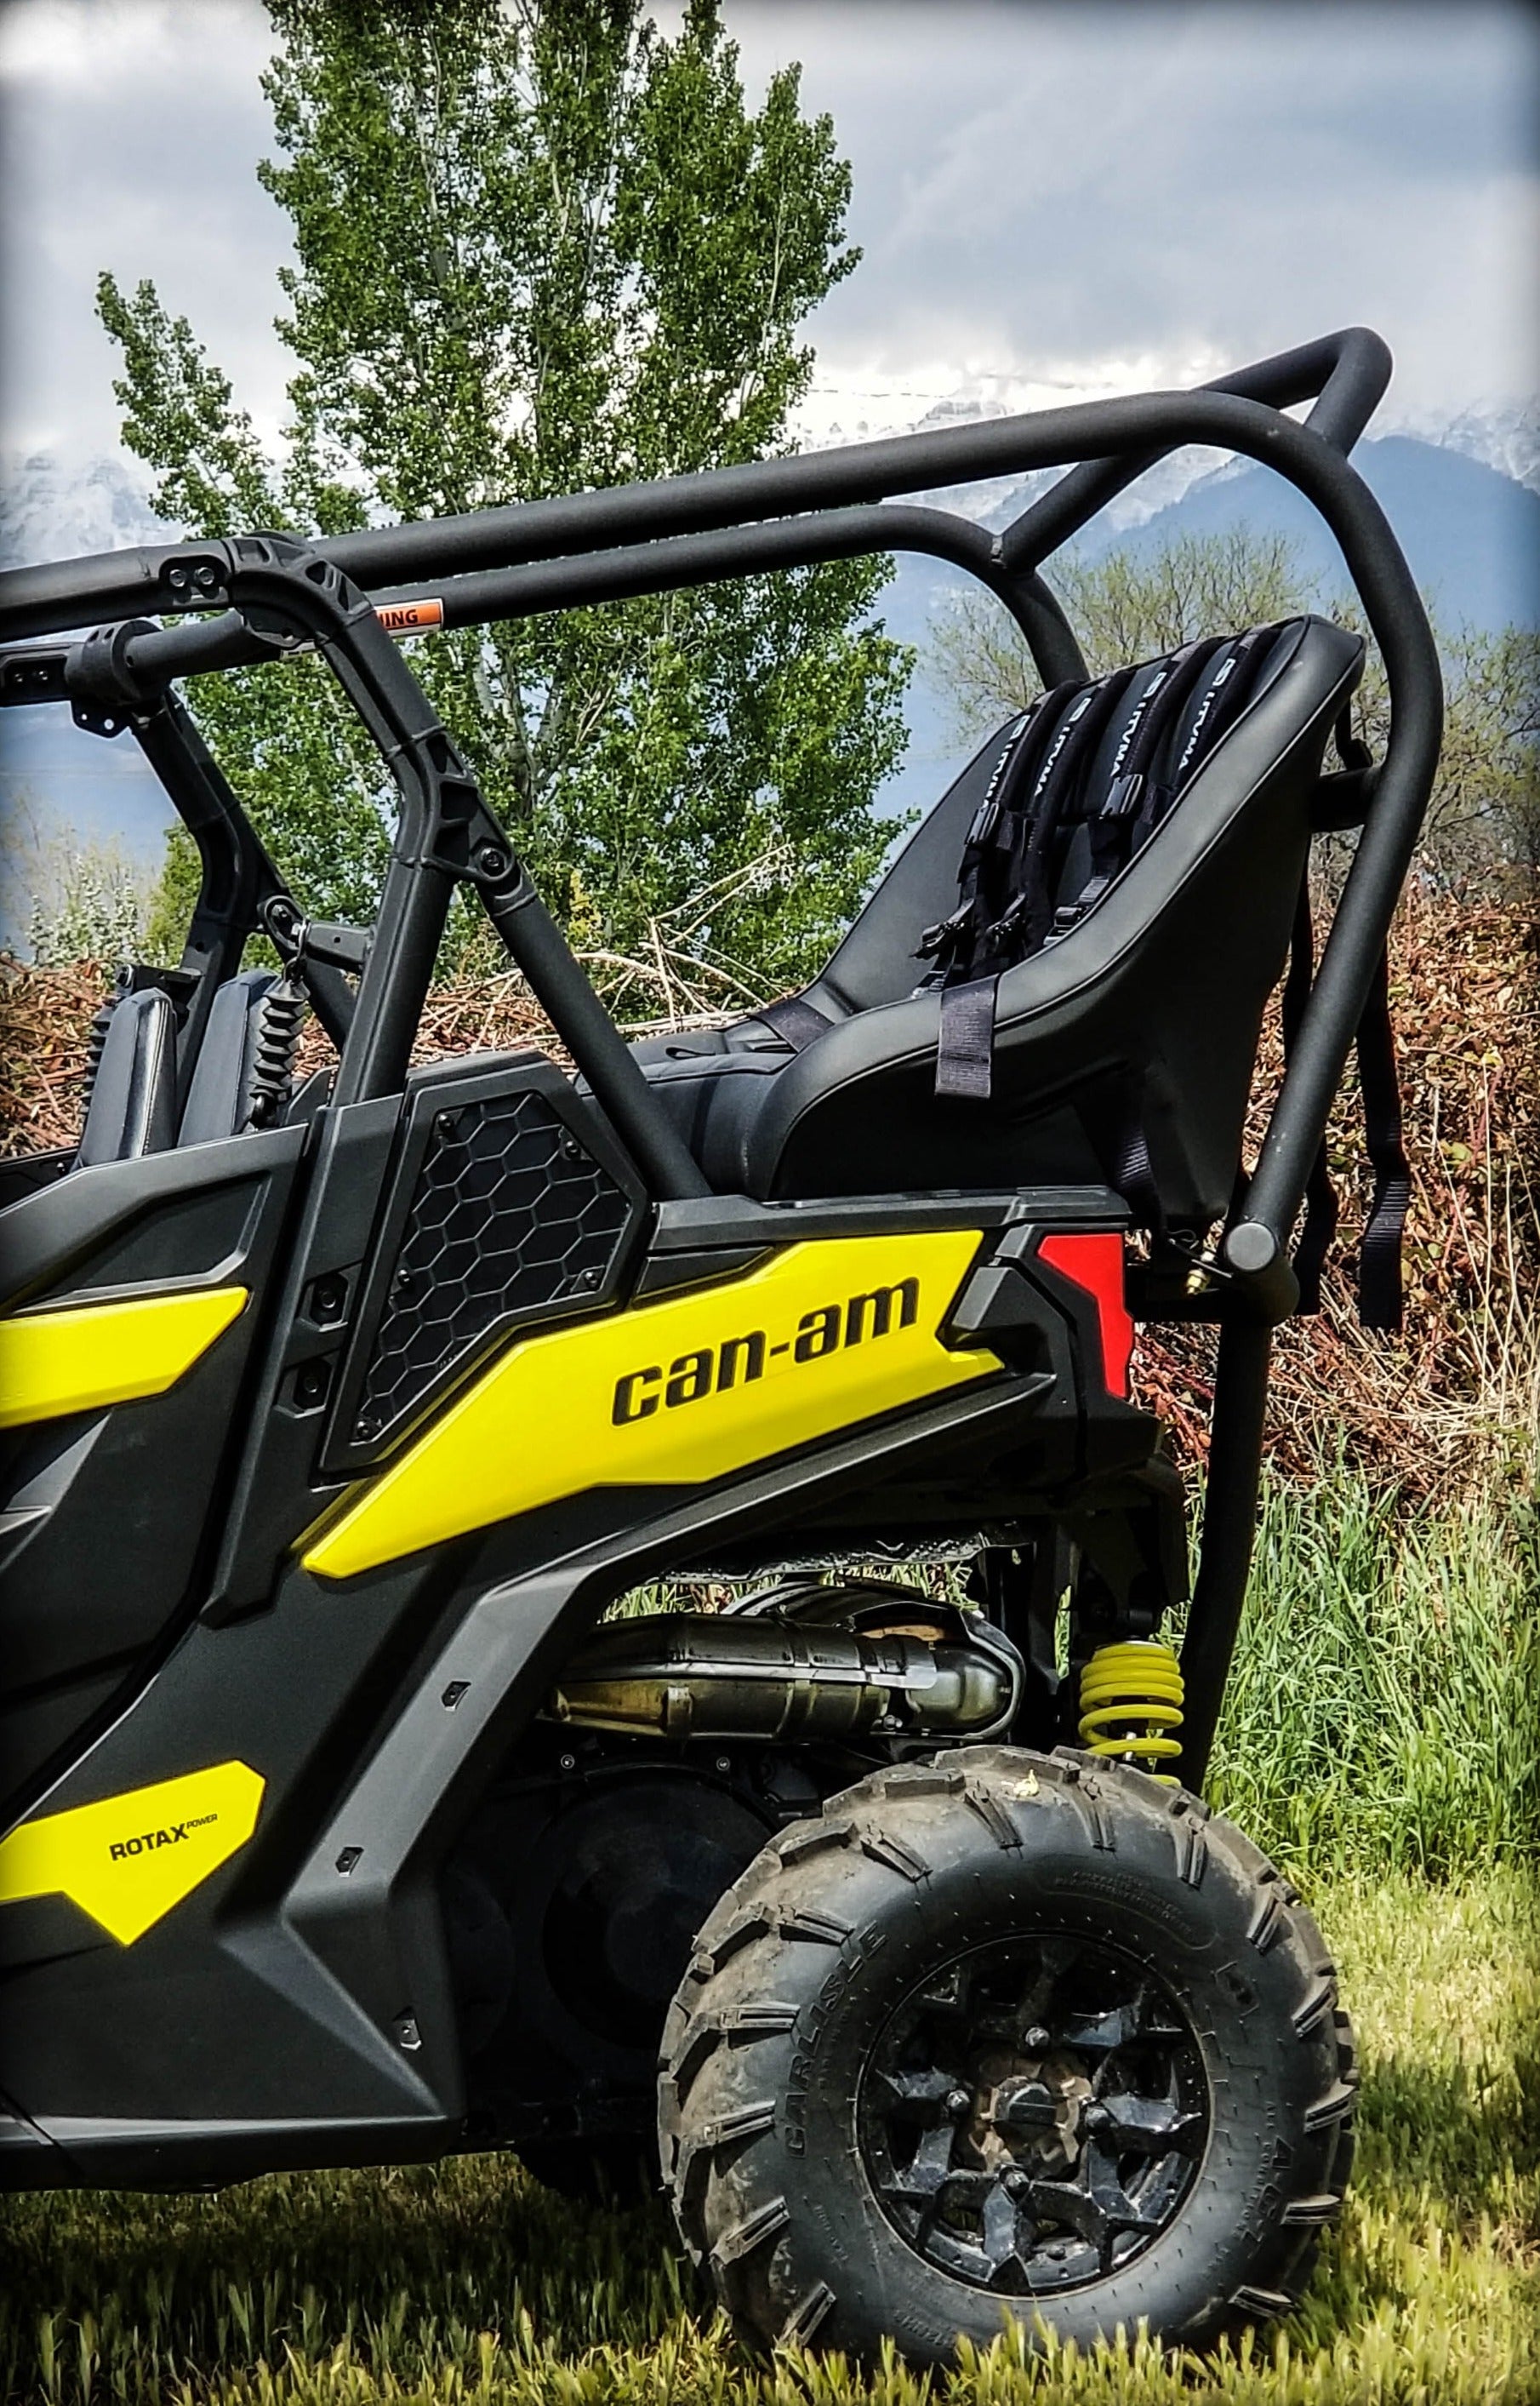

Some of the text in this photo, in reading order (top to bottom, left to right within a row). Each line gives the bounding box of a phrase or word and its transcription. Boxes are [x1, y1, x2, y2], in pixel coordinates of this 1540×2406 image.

[612, 1277, 920, 1426] can-am
[109, 1813, 218, 1861] ROTAX POWER
[784, 1919, 886, 2158] CARLISLE
